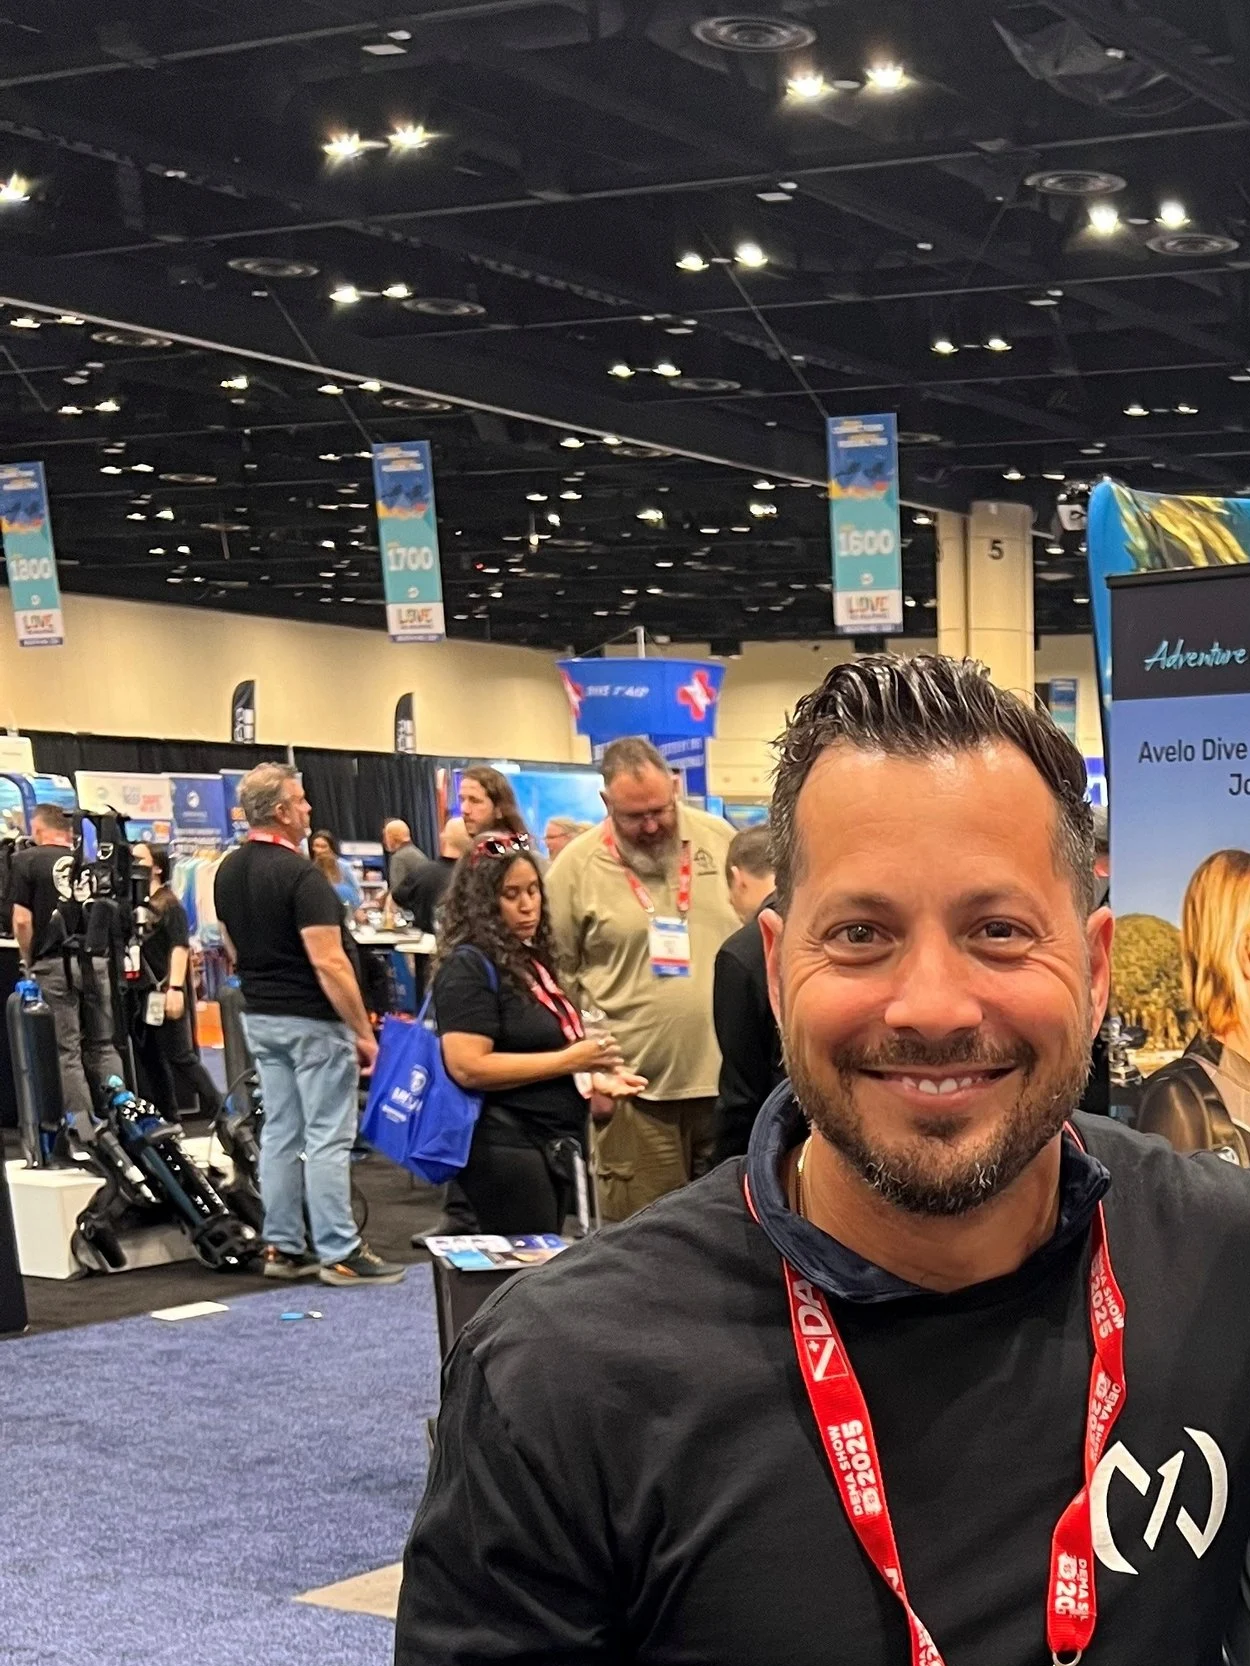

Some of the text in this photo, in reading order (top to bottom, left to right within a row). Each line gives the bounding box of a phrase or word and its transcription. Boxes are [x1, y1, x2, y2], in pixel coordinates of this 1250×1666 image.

[838, 528, 895, 557] 1600
[987, 538, 1005, 561] 5
[387, 546, 435, 572] 1700
[1144, 637, 1249, 672] Adventure
[1138, 738, 1195, 764] Avelo
[1201, 736, 1249, 761] Dive
[793, 1278, 833, 1336] DA
[841, 1418, 877, 1487] 2025
[827, 1424, 865, 1516] DEMA SHOW
